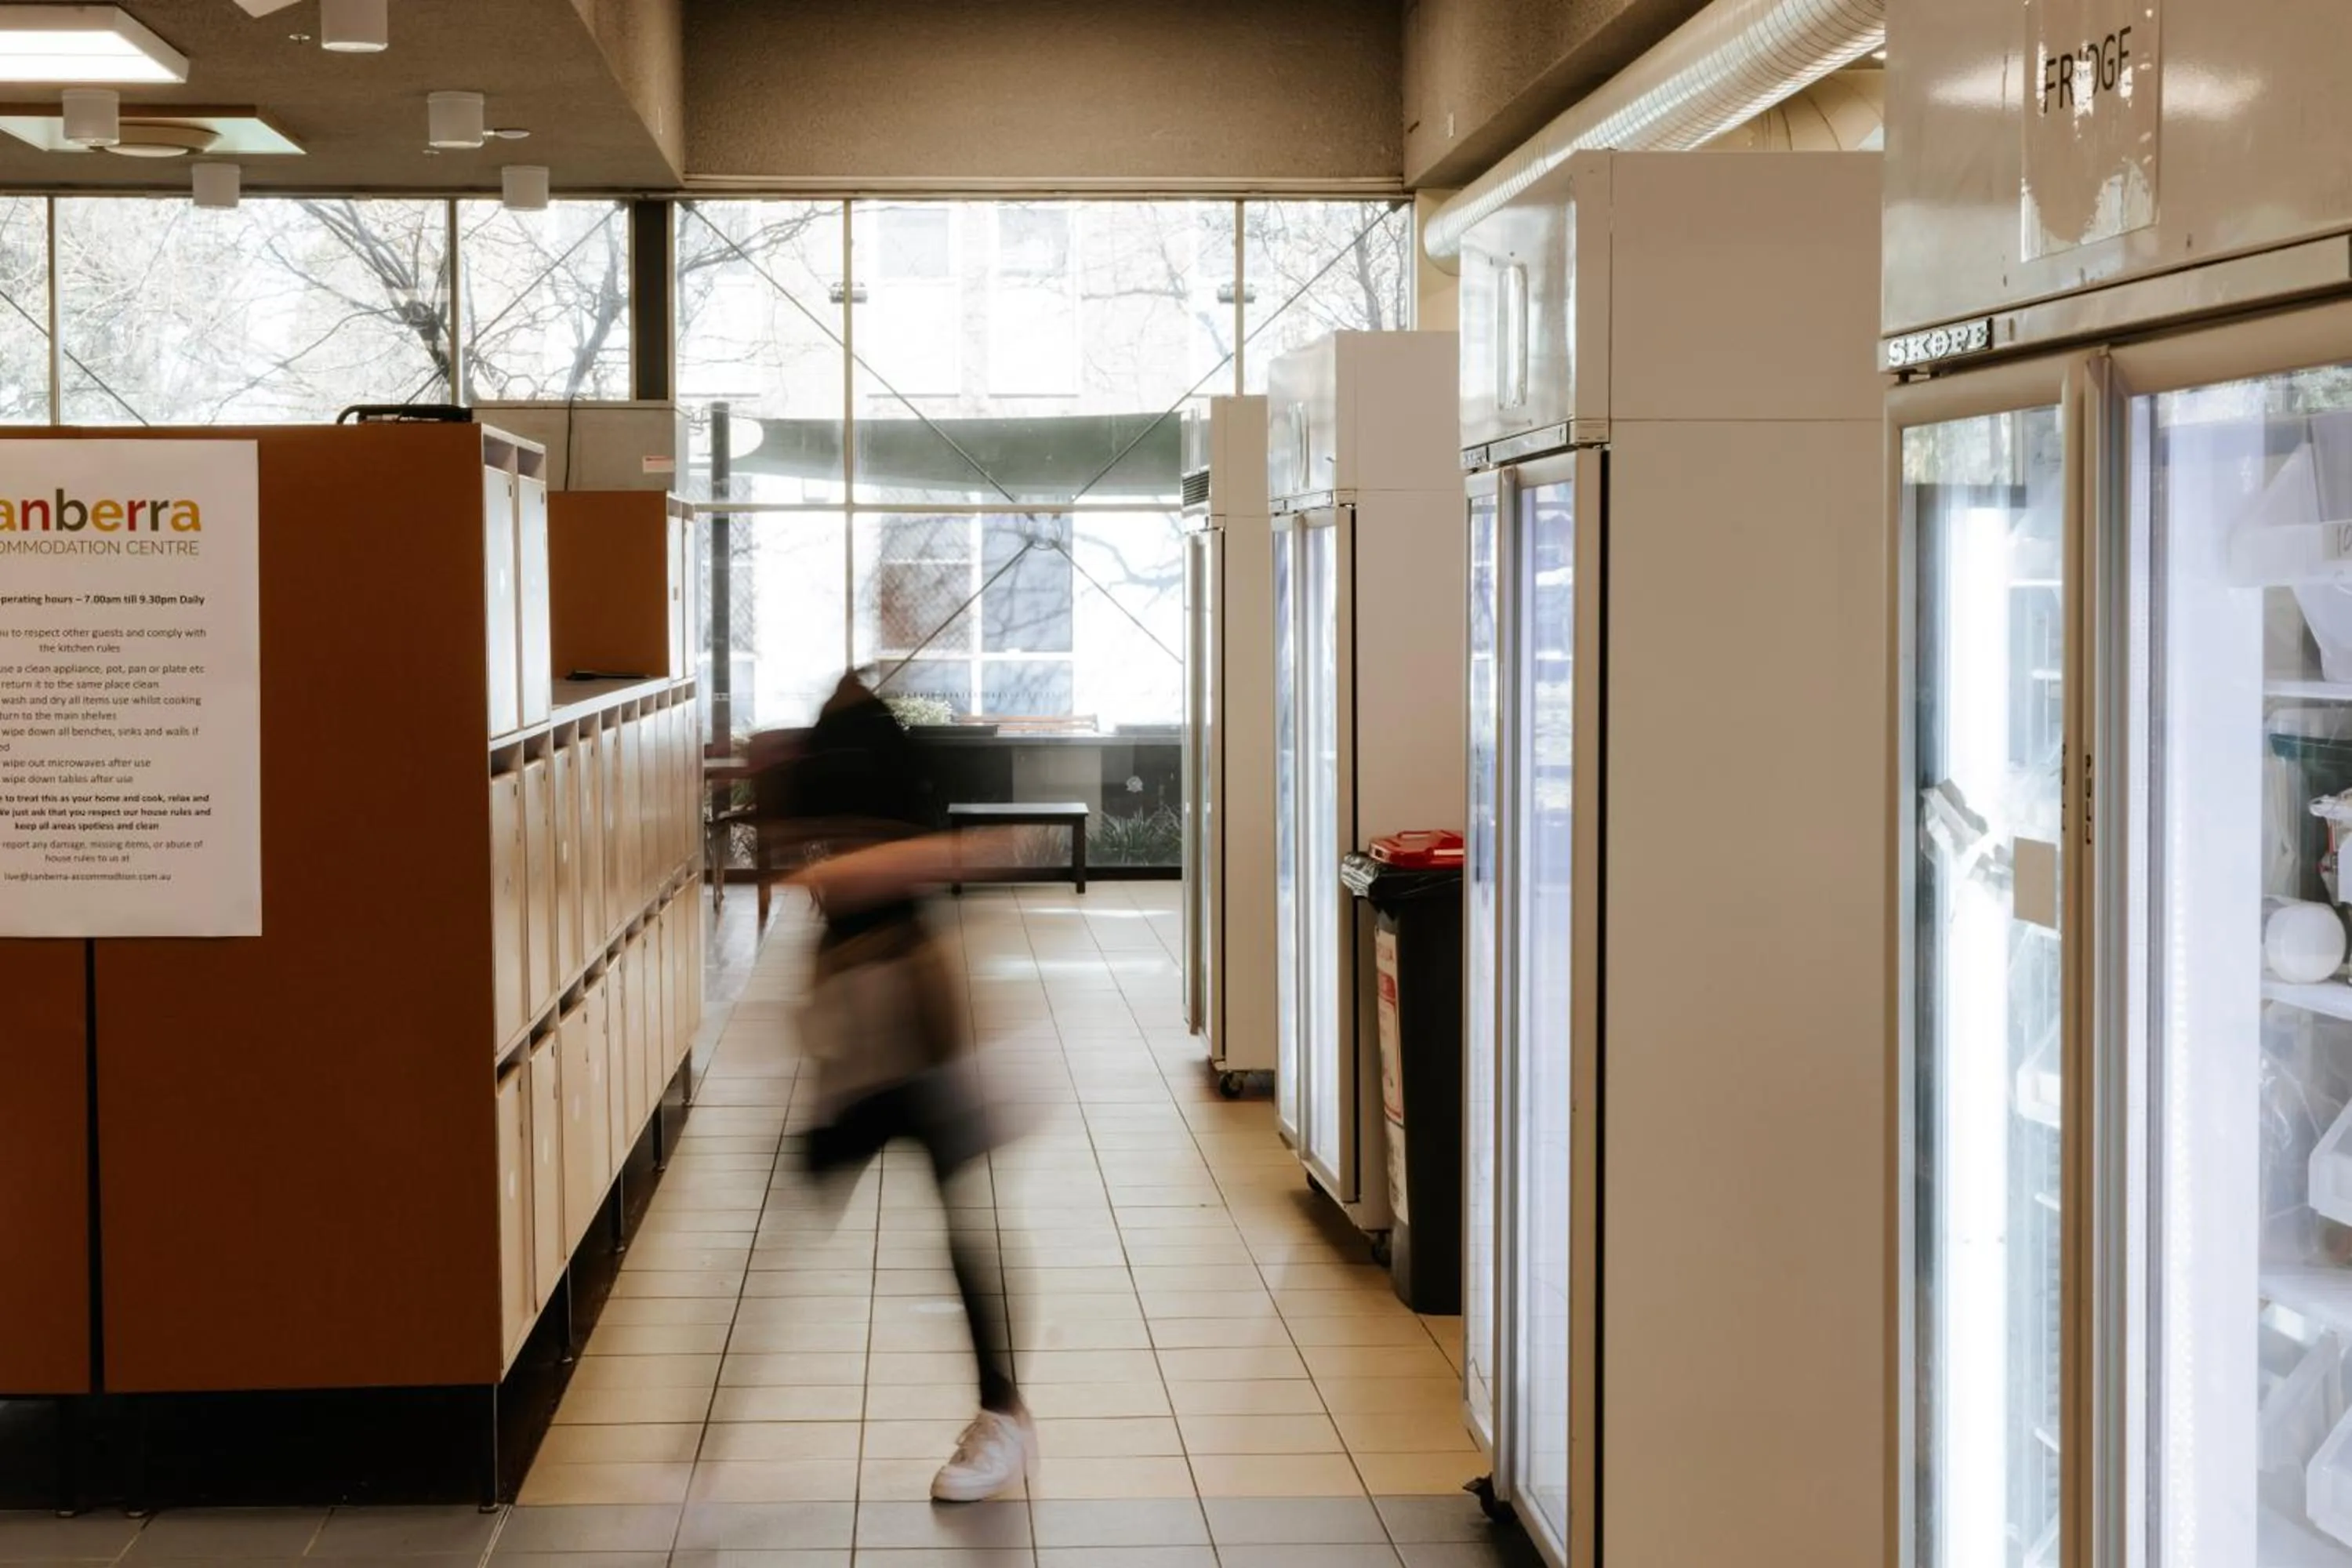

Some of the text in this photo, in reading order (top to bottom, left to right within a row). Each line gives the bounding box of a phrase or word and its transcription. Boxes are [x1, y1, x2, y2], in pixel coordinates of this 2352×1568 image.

[2043, 25, 2132, 114] FRDGE
[1888, 320, 1988, 367] SKOPE
[0, 488, 201, 532] anberra
[126, 540, 199, 556] CENTRE
[45, 594, 72, 604] hours
[85, 595, 121, 604] 7.00am
[124, 595, 137, 604] till
[140, 596, 177, 606] 9.30pm
[180, 595, 205, 606] Daily
[24, 630, 60, 639] respect
[63, 628, 89, 637] other
[93, 630, 123, 639] guests
[125, 629, 144, 637] and
[147, 629, 182, 639] comply
[184, 629, 206, 638] with
[39, 643, 121, 652] the kitchen rules
[24, 665, 51, 673] clean
[129, 666, 146, 674] pan
[162, 665, 187, 675] plate
[1, 681, 32, 689] return
[57, 680, 74, 688] the
[104, 680, 130, 690] place
[132, 681, 159, 689] clean
[2, 695, 26, 705] wash
[30, 695, 48, 705] and
[49, 696, 66, 706] dry
[68, 695, 81, 705] all
[82, 696, 110, 705] items
[132, 695, 161, 705] whilst
[163, 696, 201, 706] cooking
[35, 711, 51, 720] the
[54, 712, 79, 720] main
[82, 711, 117, 720] shelves
[2, 728, 25, 737] wipe
[28, 728, 56, 736] down
[58, 727, 70, 736] all
[118, 728, 142, 736] sinks
[144, 728, 162, 736] and
[165, 727, 189, 736] walls
[3, 759, 25, 768] wipe
[48, 759, 105, 768] microwaves
[108, 758, 132, 768] after
[2, 775, 25, 785] wipe
[28, 775, 56, 783] down
[58, 774, 88, 783] tables
[90, 774, 112, 783] after
[12, 808, 29, 818] just
[88, 809, 121, 818] respect
[140, 808, 168, 816] house
[170, 808, 192, 816] rules
[15, 822, 37, 831] keep
[39, 822, 49, 830] all
[78, 822, 114, 831] spotless
[136, 822, 159, 830] clean
[2, 841, 30, 850] report
[32, 841, 48, 851] any
[90, 840, 123, 851] missing
[166, 840, 192, 849] abuse
[194, 840, 204, 849] of
[45, 854, 71, 862] house
